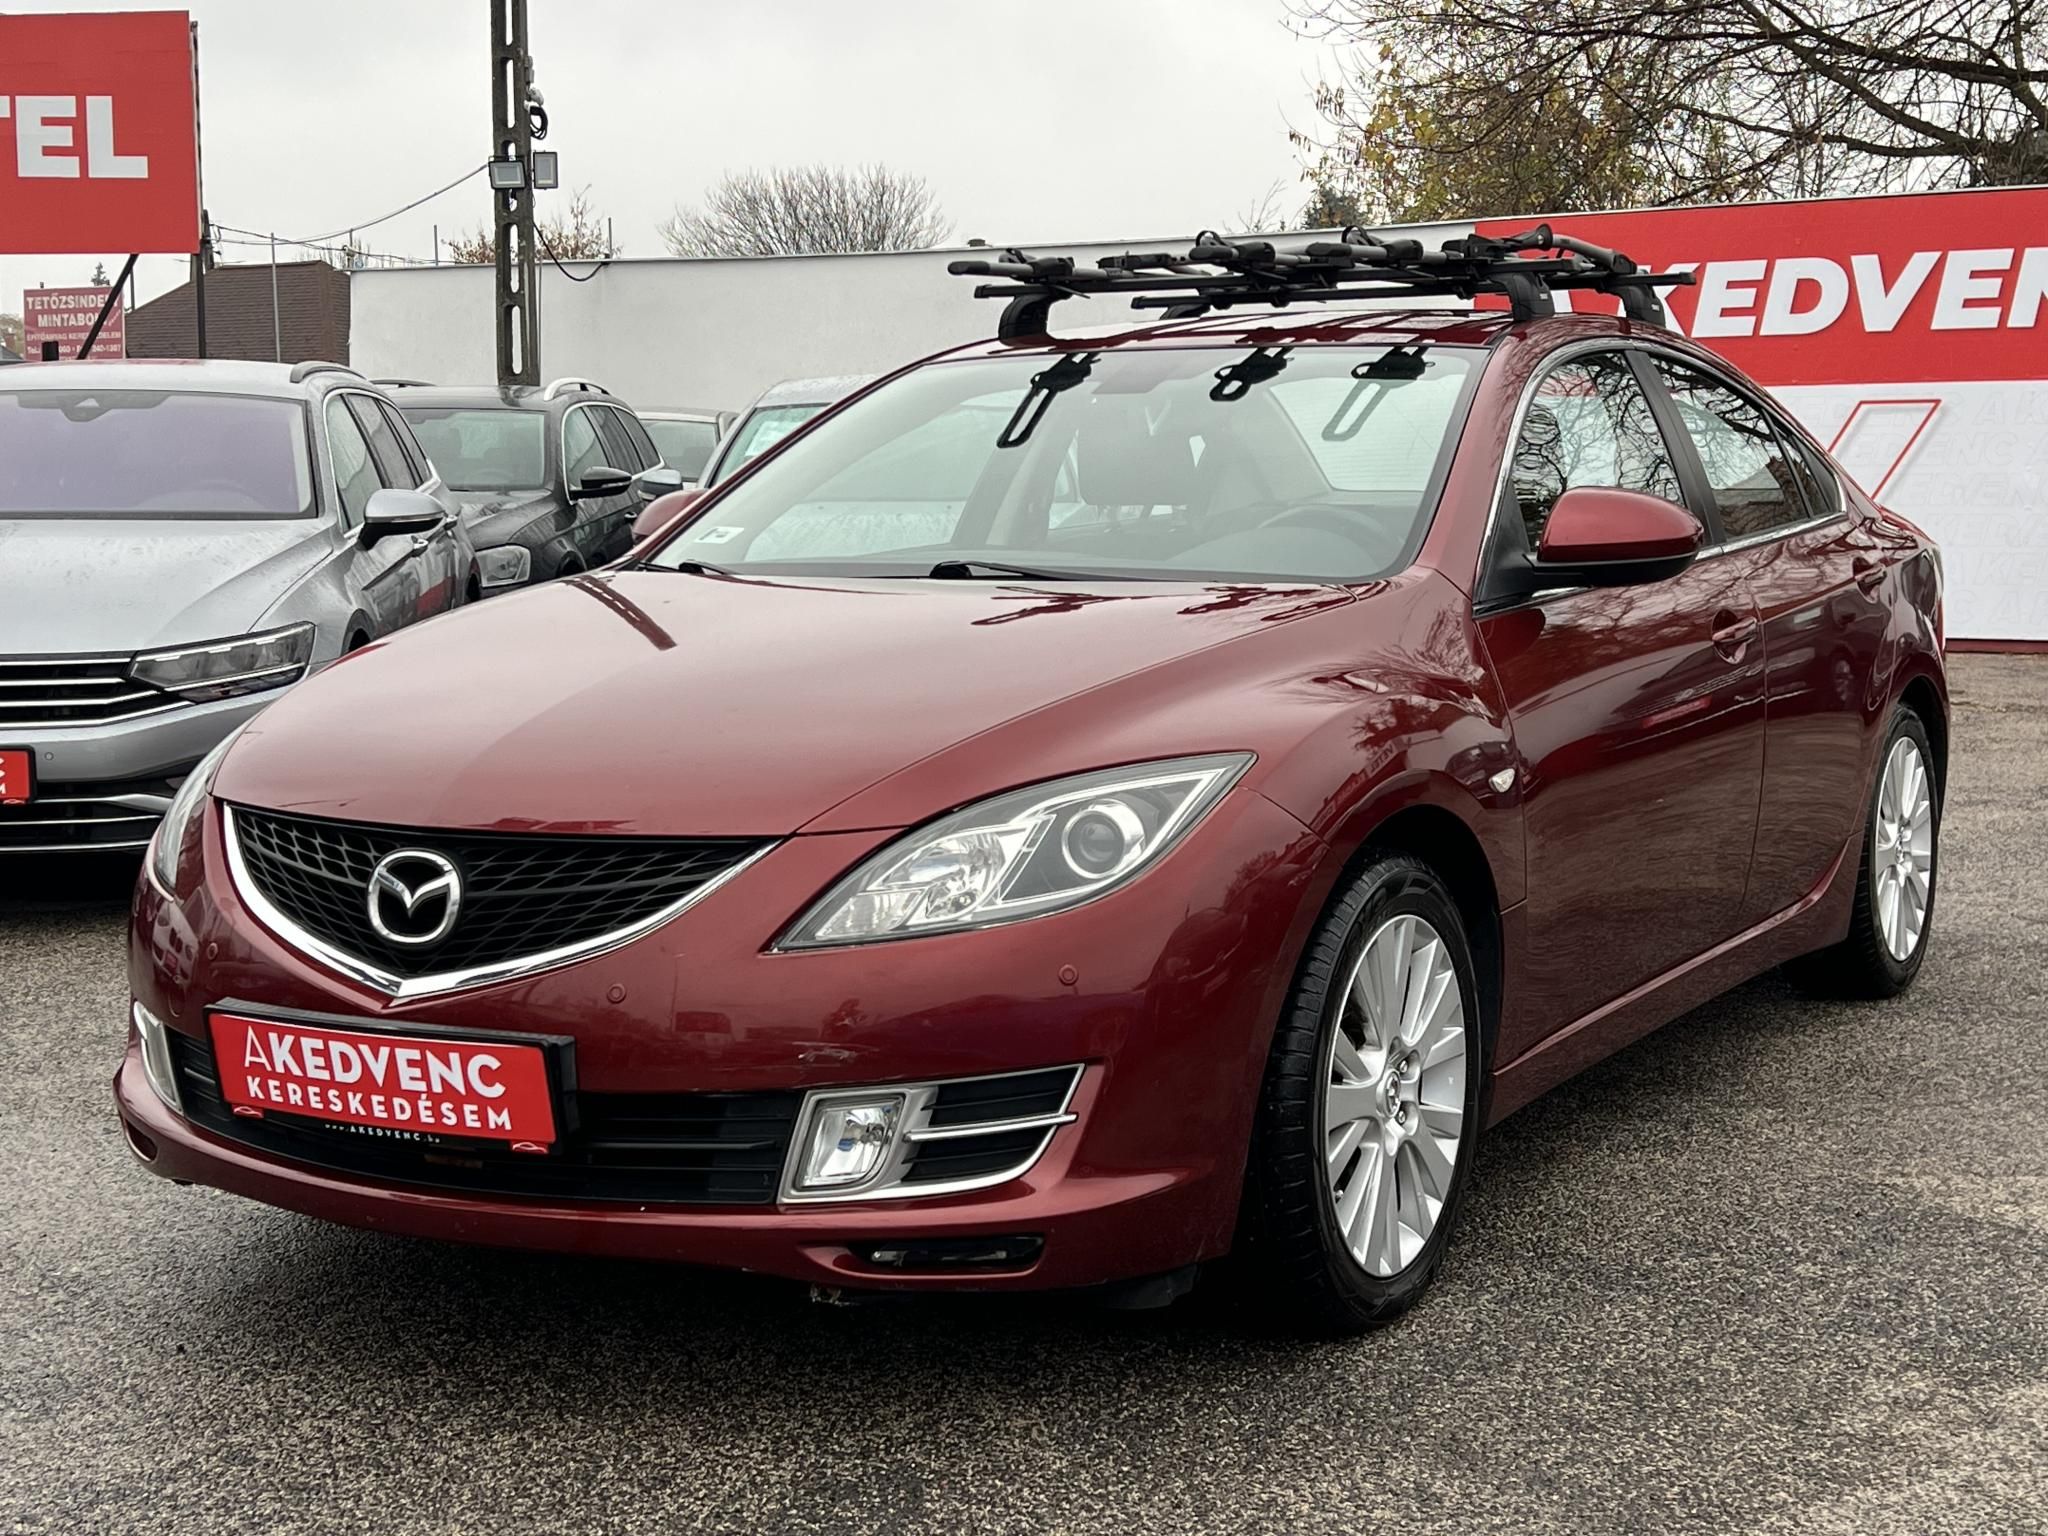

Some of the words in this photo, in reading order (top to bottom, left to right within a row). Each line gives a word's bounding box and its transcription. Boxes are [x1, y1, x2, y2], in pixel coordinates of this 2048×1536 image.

[0, 95, 148, 178] EL
[26, 292, 119, 310] TETŐZSINDE
[37, 312, 107, 328] MINTABO
[244, 1025, 506, 1098] AKEDVENC
[246, 1076, 512, 1130] KERESKEDÉSEM
